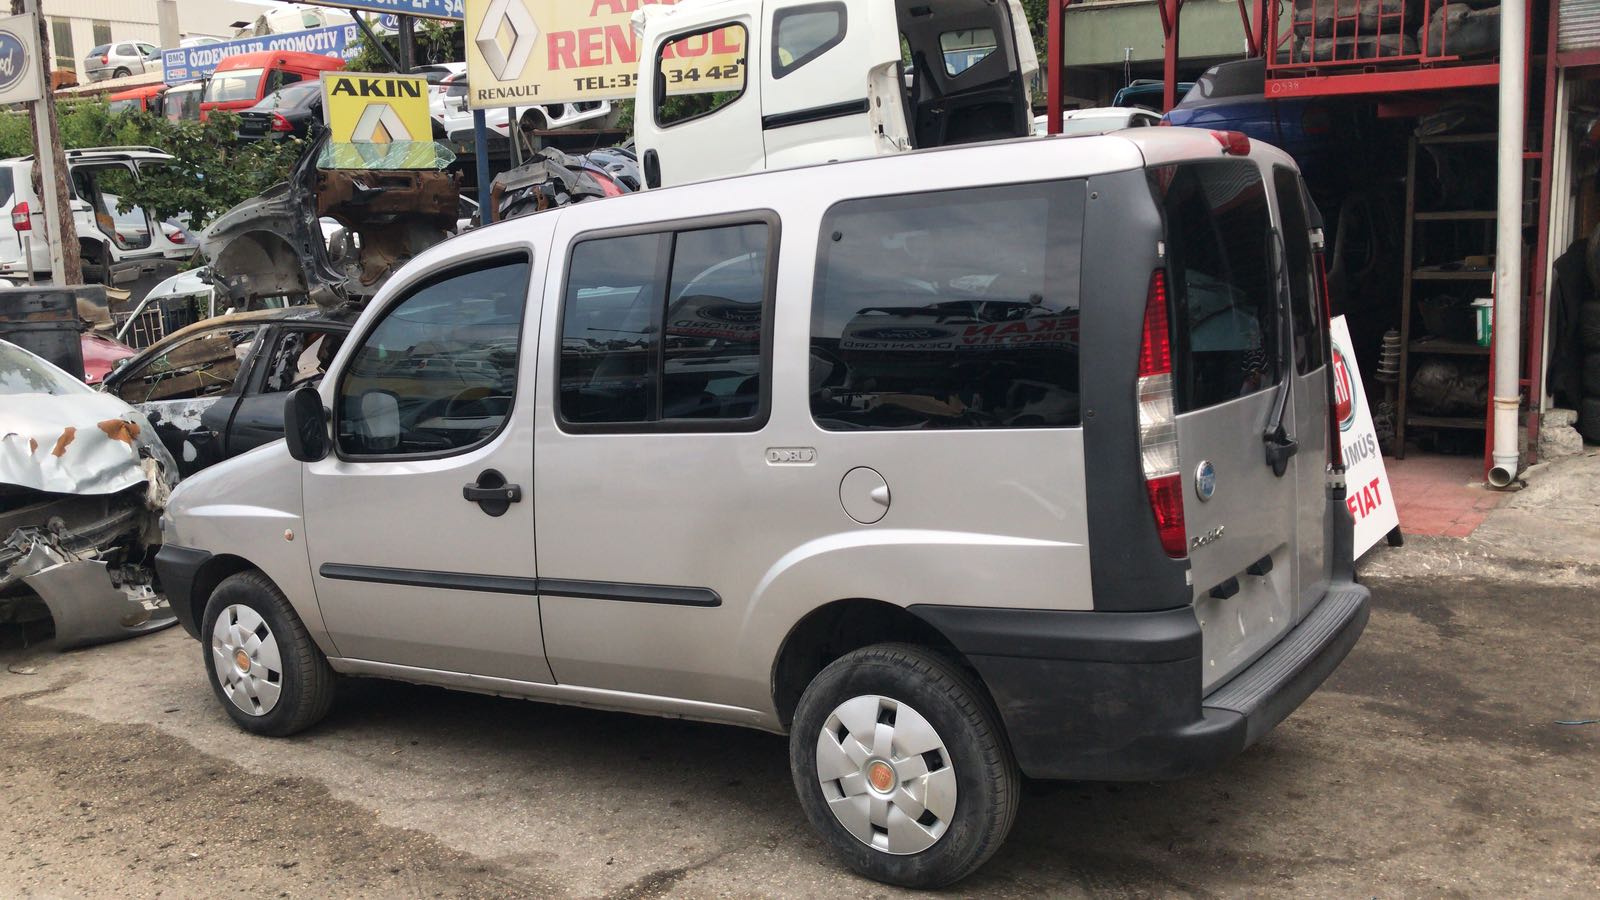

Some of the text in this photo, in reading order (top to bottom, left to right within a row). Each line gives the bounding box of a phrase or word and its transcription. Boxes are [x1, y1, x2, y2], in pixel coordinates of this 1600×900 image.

[168, 53, 184, 63] BMC
[669, 68, 701, 84] 34
[705, 65, 739, 80] 42
[331, 78, 421, 98] AKIN
[478, 84, 541, 100] RENAULT
[1347, 477, 1382, 526] FIAT
